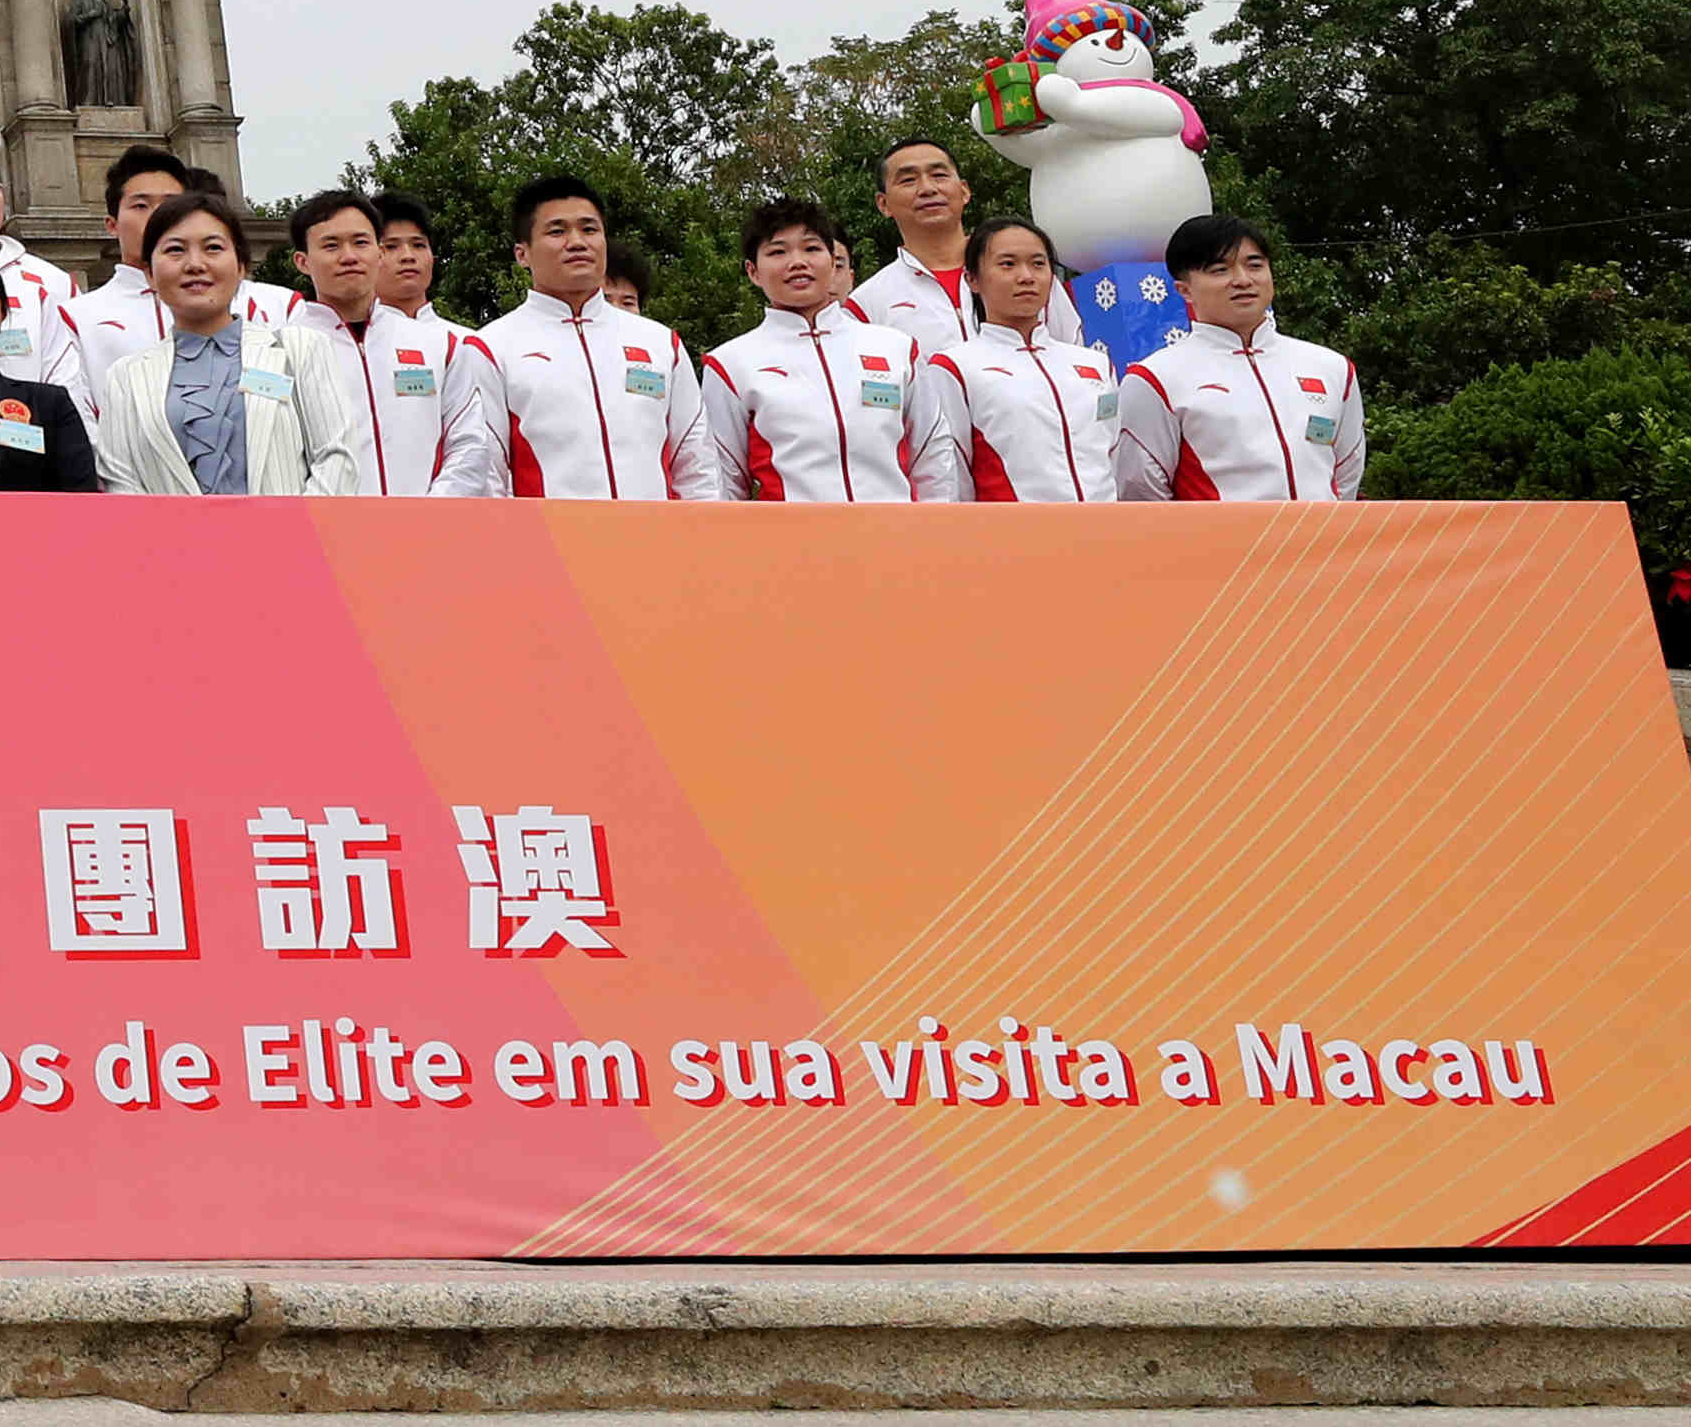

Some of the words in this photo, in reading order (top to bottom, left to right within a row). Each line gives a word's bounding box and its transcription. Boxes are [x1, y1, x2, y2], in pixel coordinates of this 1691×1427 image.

[94, 1020, 212, 1105] de
[243, 1016, 465, 1103] Elite
[494, 1040, 642, 1102] em
[670, 1038, 837, 1101] sua
[859, 1015, 1132, 1101] visita
[1157, 1039, 1213, 1101] a
[1235, 1023, 1548, 1100] Macau
